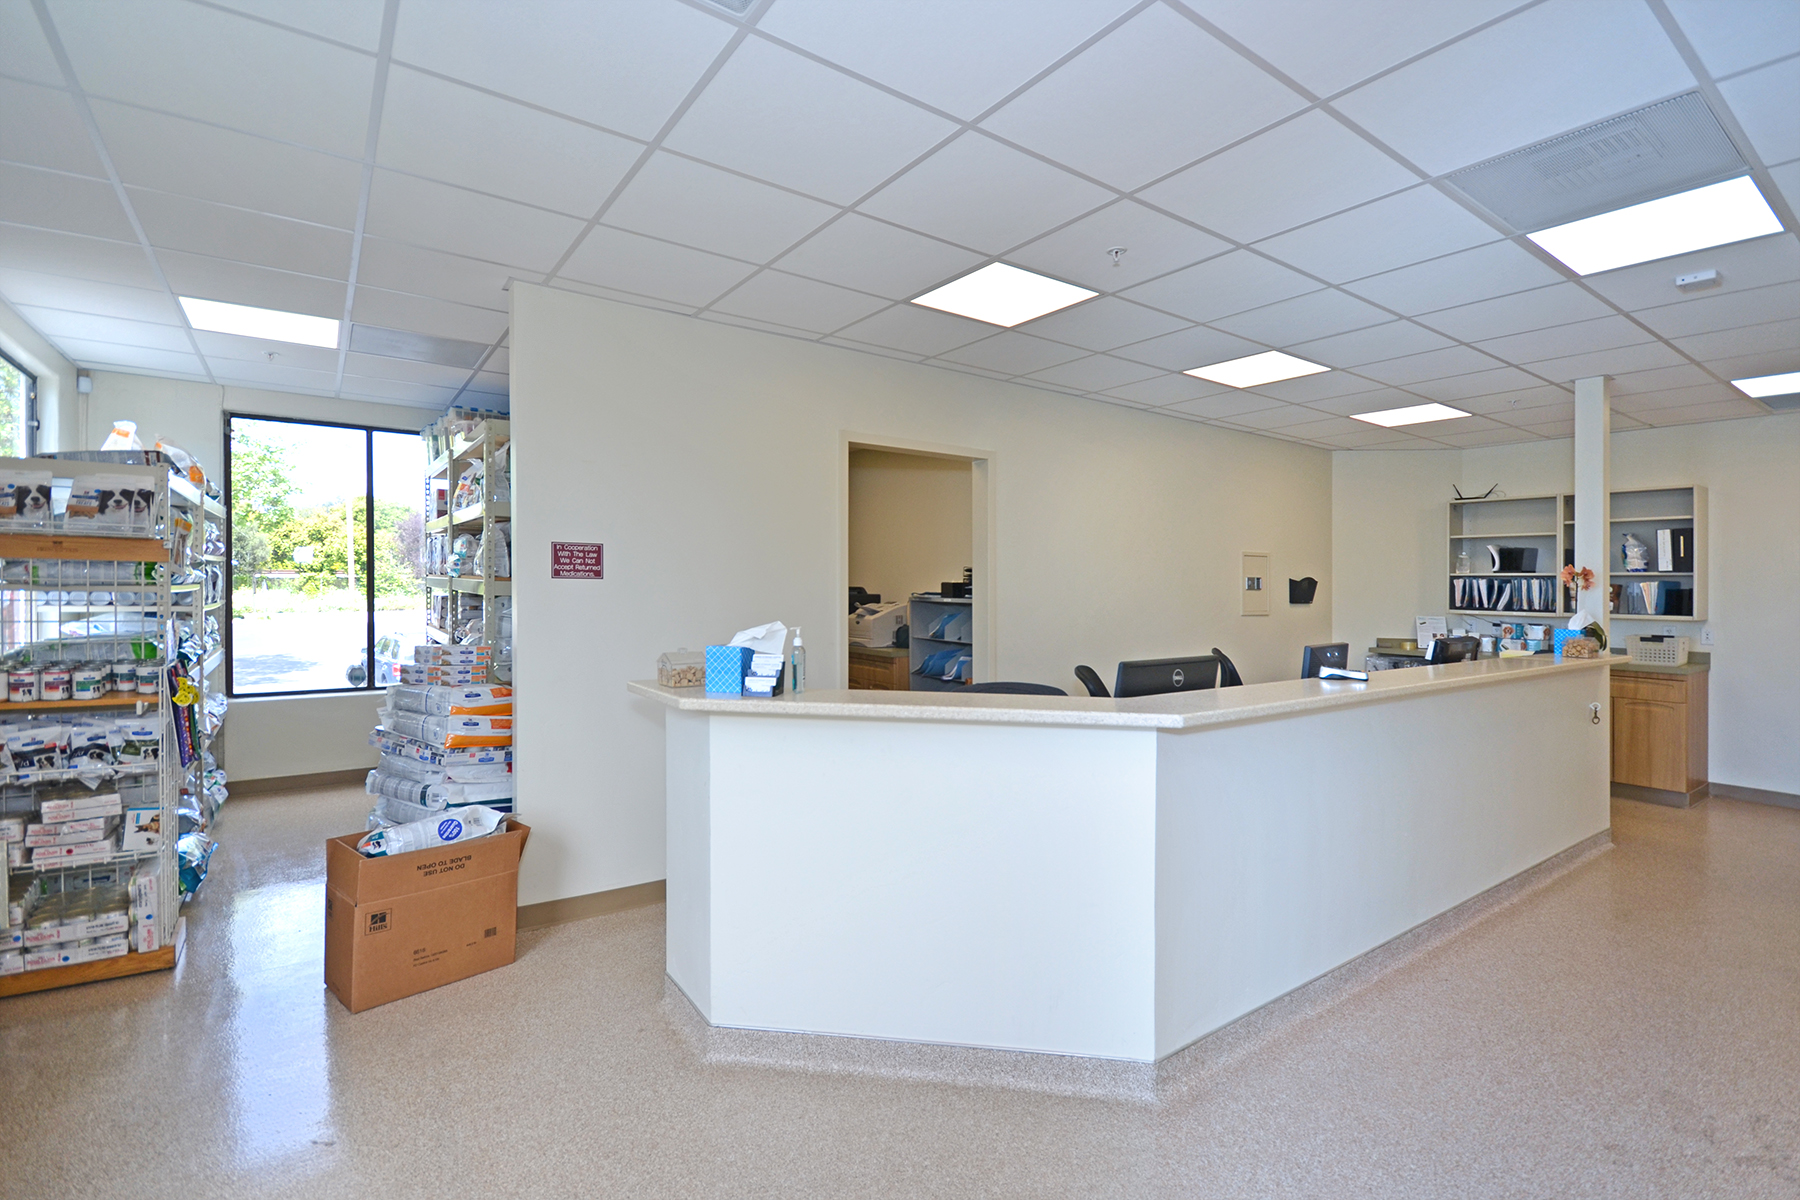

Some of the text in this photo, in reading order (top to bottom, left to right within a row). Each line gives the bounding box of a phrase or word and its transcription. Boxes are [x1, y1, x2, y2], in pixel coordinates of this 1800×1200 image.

[449, 855, 472, 864] BLADE
[416, 862, 437, 871] OPEN
[439, 866, 454, 874] NOT
[423, 869, 438, 877] USE
